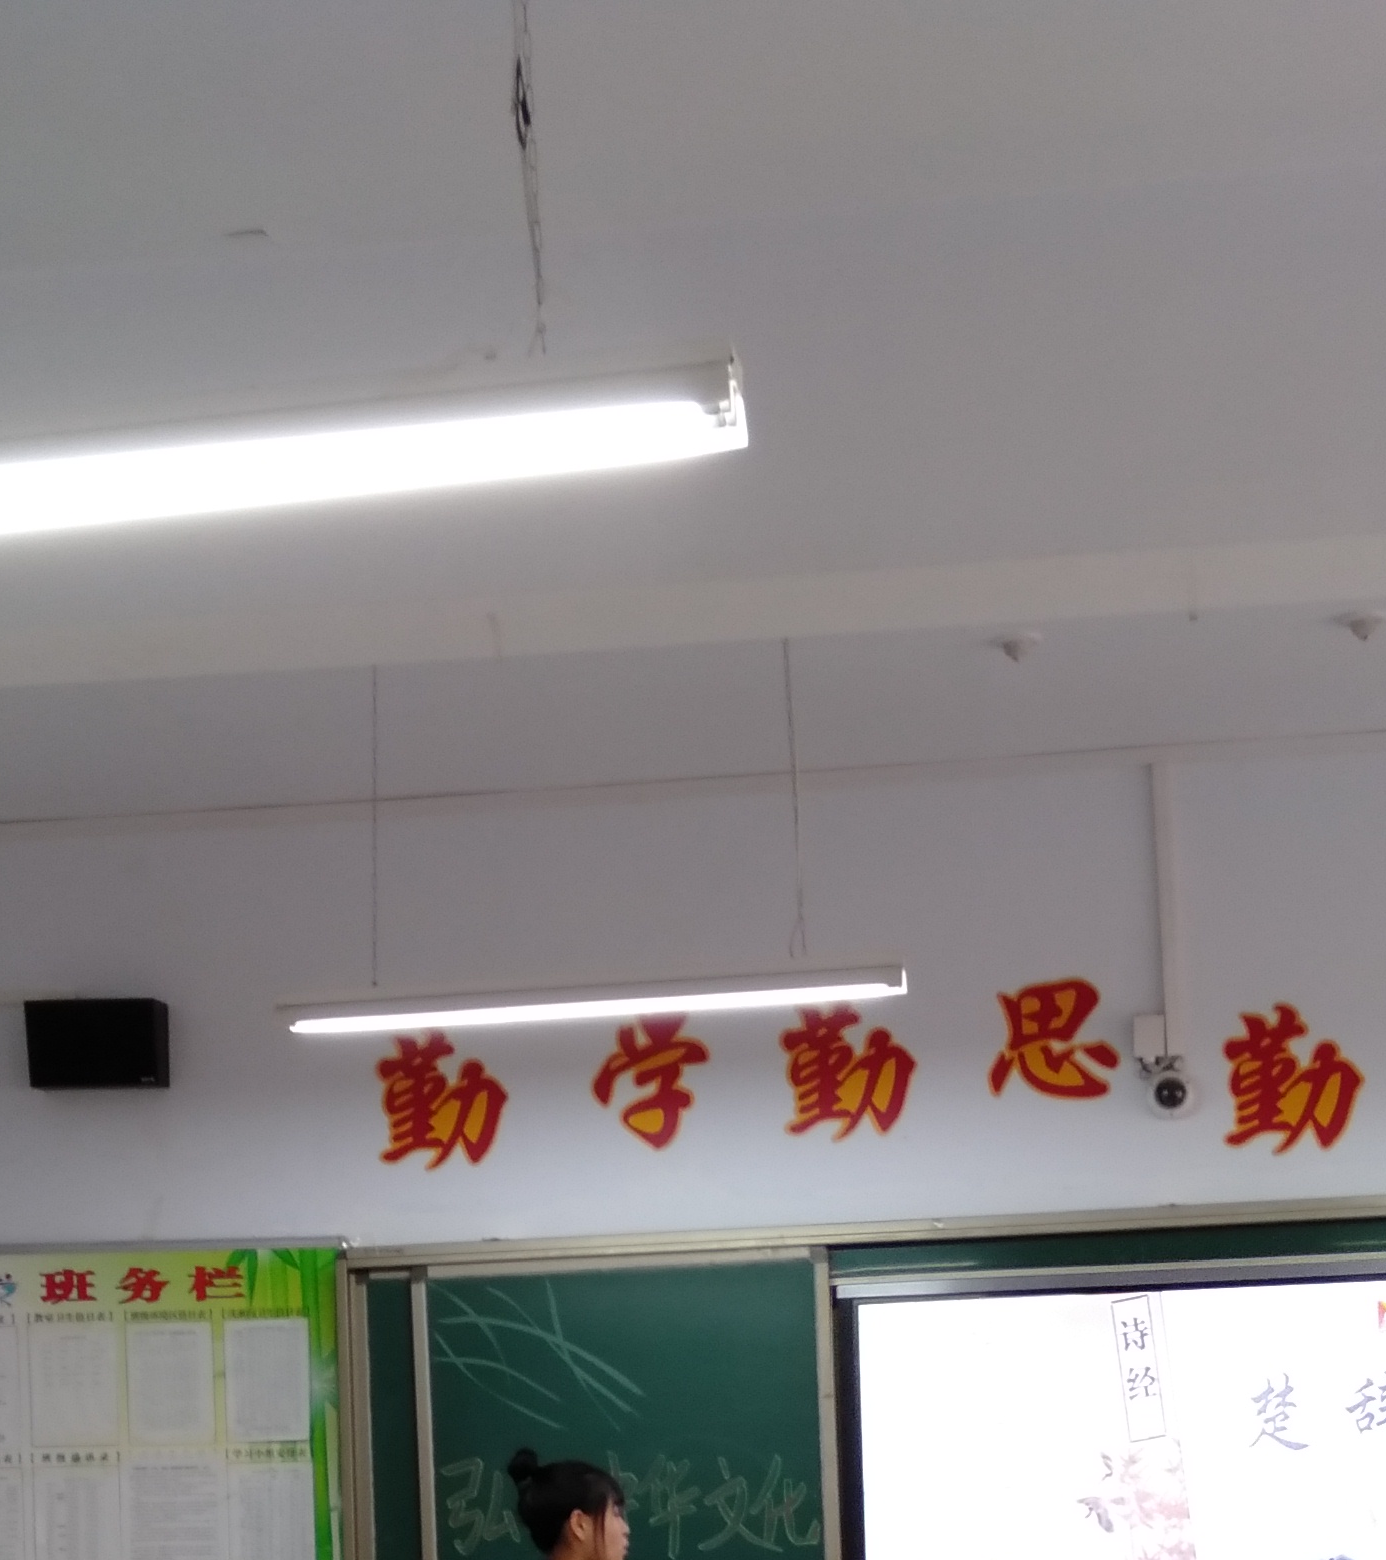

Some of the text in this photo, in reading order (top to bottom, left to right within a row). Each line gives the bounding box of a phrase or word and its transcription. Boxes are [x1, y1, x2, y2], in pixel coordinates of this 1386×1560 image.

[39, 1265, 248, 1303] 班务栏
[1119, 1317, 1159, 1402] 诗经
